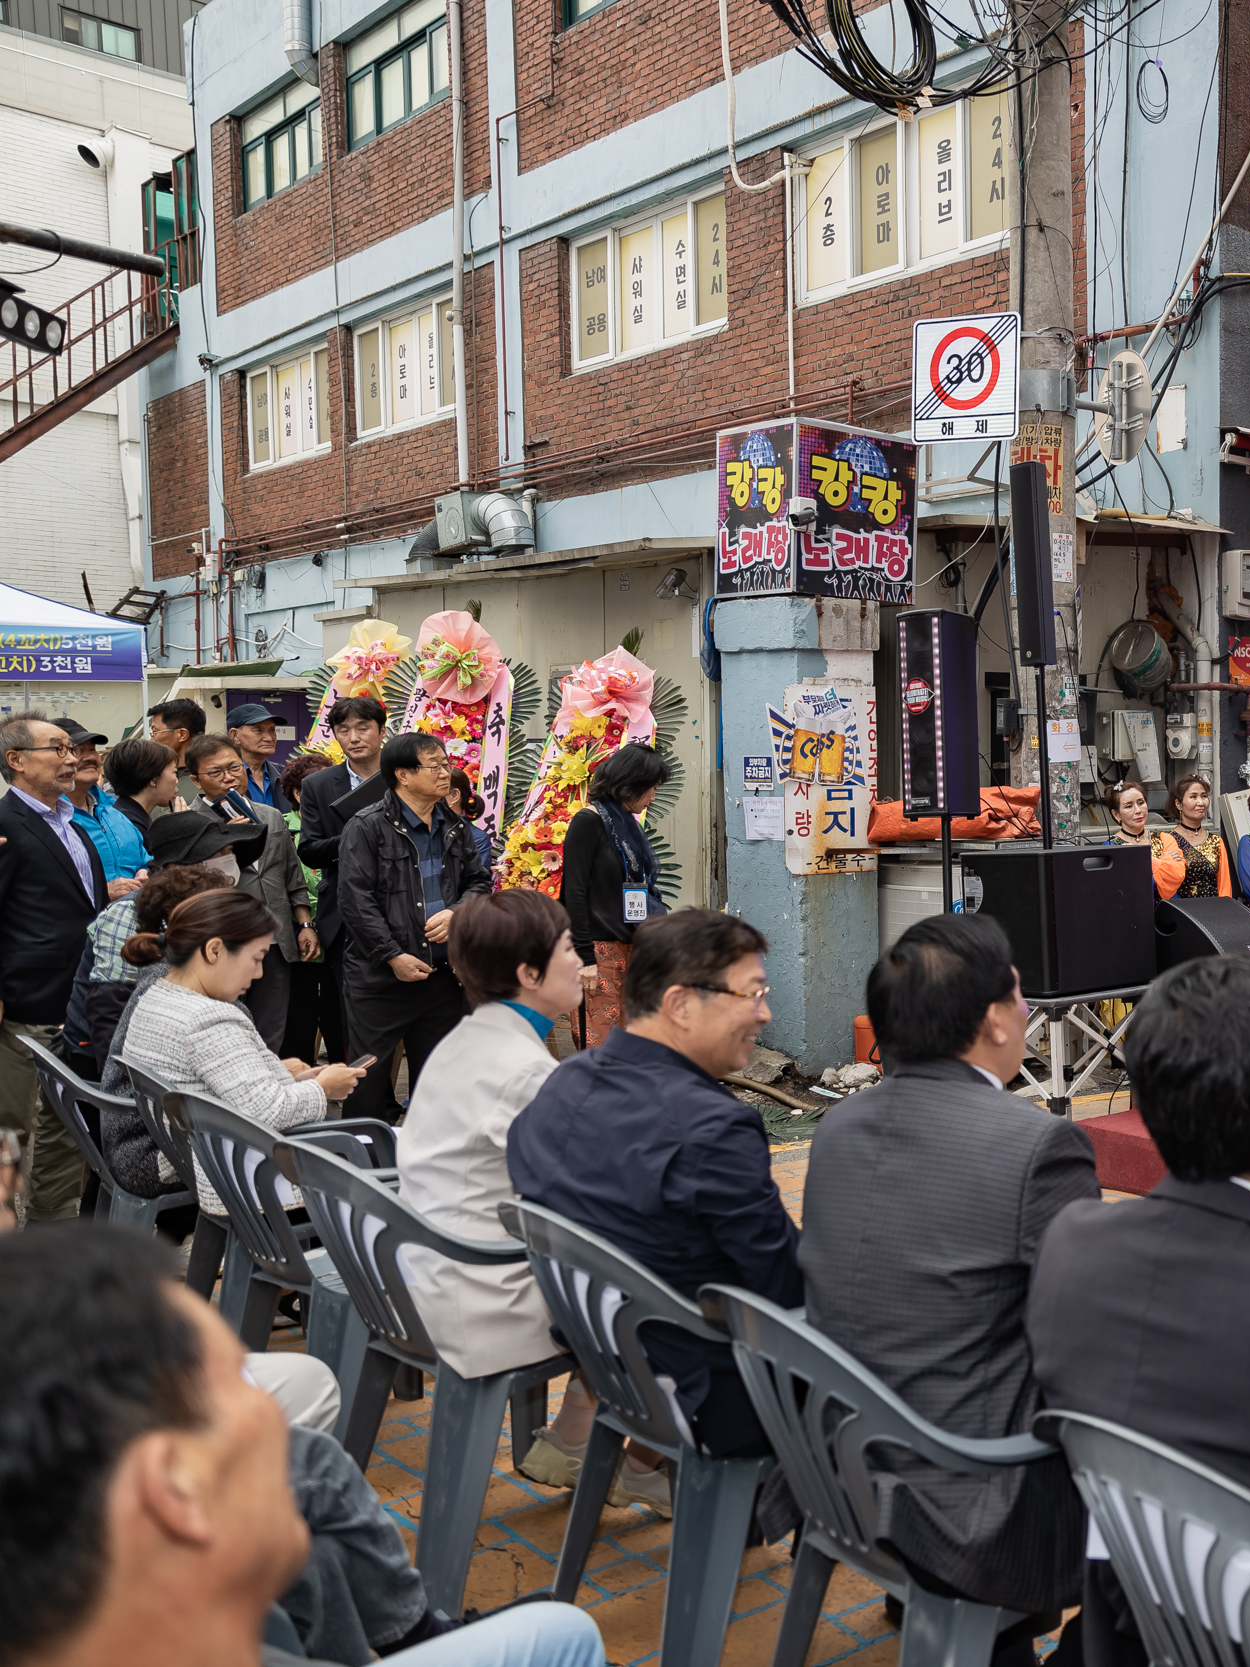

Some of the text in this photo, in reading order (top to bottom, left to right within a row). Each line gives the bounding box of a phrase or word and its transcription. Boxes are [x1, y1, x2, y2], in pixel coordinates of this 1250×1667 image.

[989, 116, 1006, 204] 24시
[937, 138, 953, 224] 올리브
[822, 197, 836, 247] 2층
[876, 162, 892, 244] 아로마
[586, 264, 606, 289] 남여
[675, 239, 687, 310] 수면실
[711, 223, 723, 295] 24시
[631, 255, 643, 325] 샤워실
[586, 312, 607, 336] 공용
[370, 362, 378, 399] 2층
[398, 343, 407, 400] 아로마
[946, 351, 984, 385] 30
[0, 632, 113, 652] (4꼬치)5천원
[39, 656, 93, 674] 3천원
[825, 687, 837, 701] 더
[488, 702, 506, 746] 축
[800, 730, 836, 759] Cass
[745, 766, 771, 778] 주차금지
